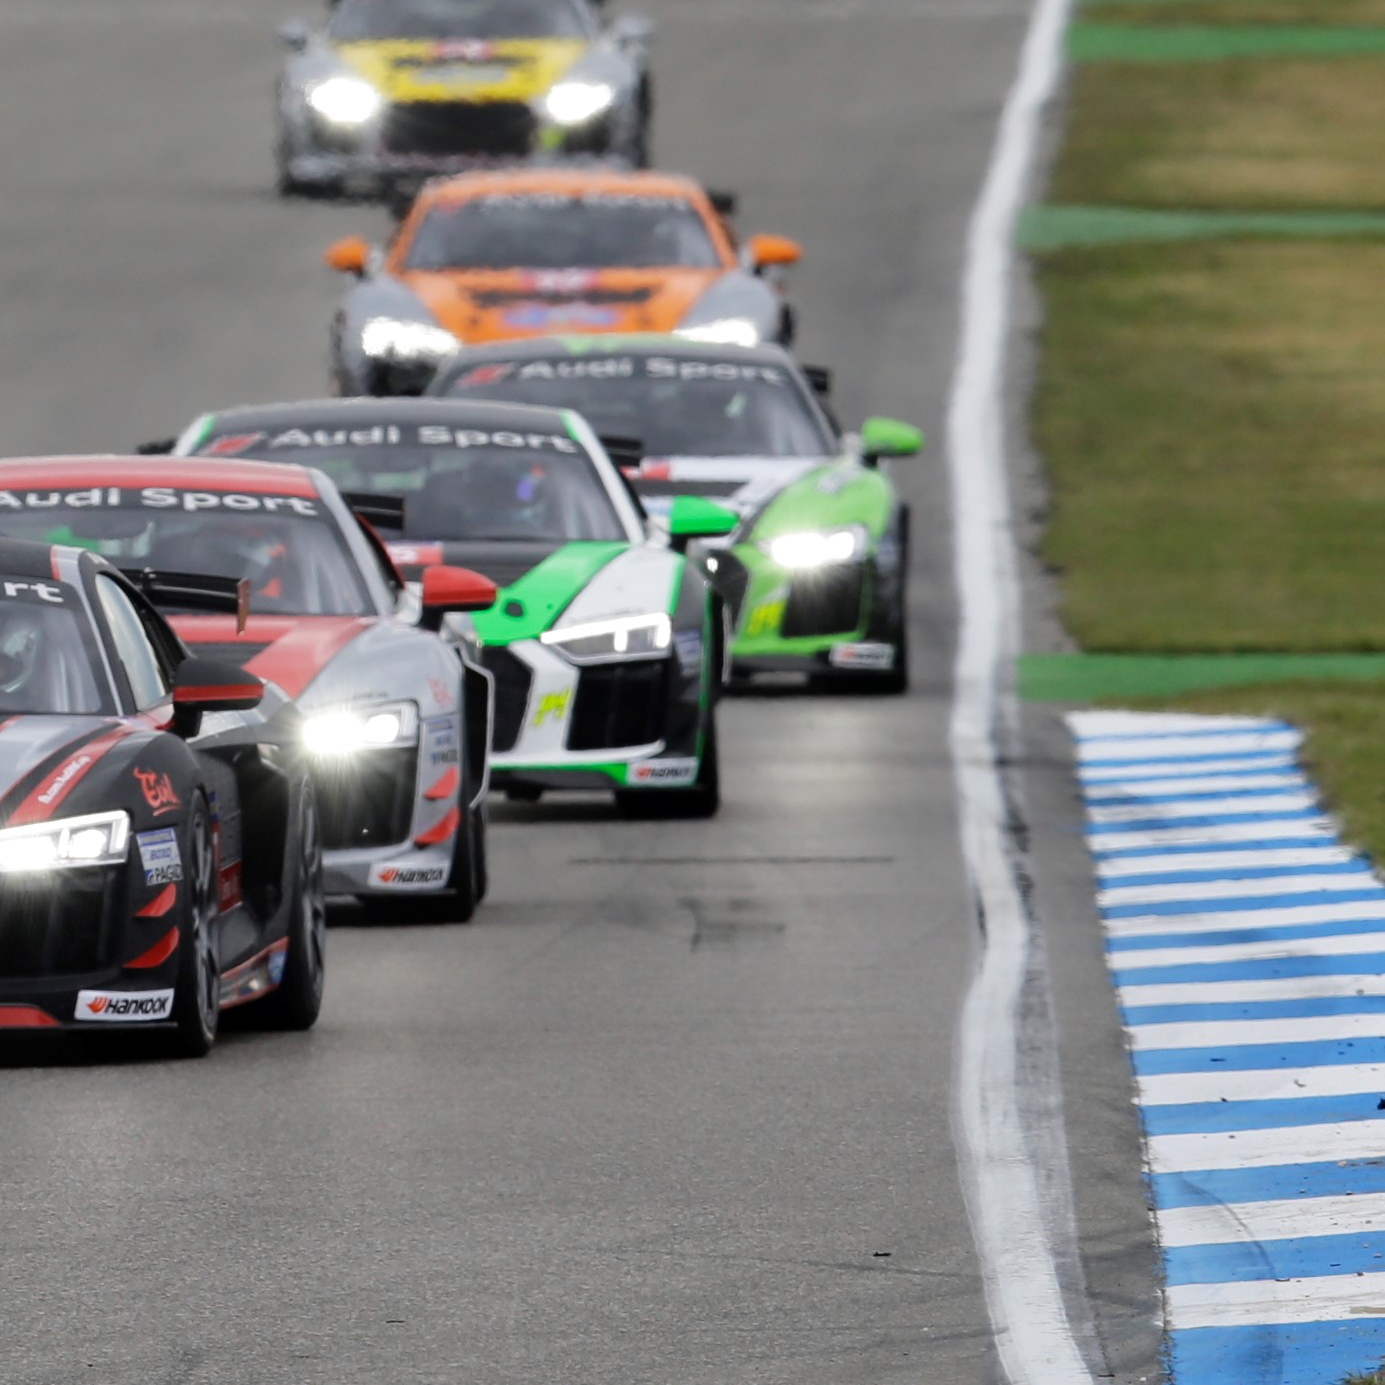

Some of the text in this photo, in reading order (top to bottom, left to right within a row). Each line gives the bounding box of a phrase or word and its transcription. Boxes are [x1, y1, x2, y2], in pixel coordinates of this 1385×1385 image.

[521, 357, 787, 386] Audi Sport
[274, 425, 577, 454] Audi Sport
[141, 487, 319, 517] Sport
